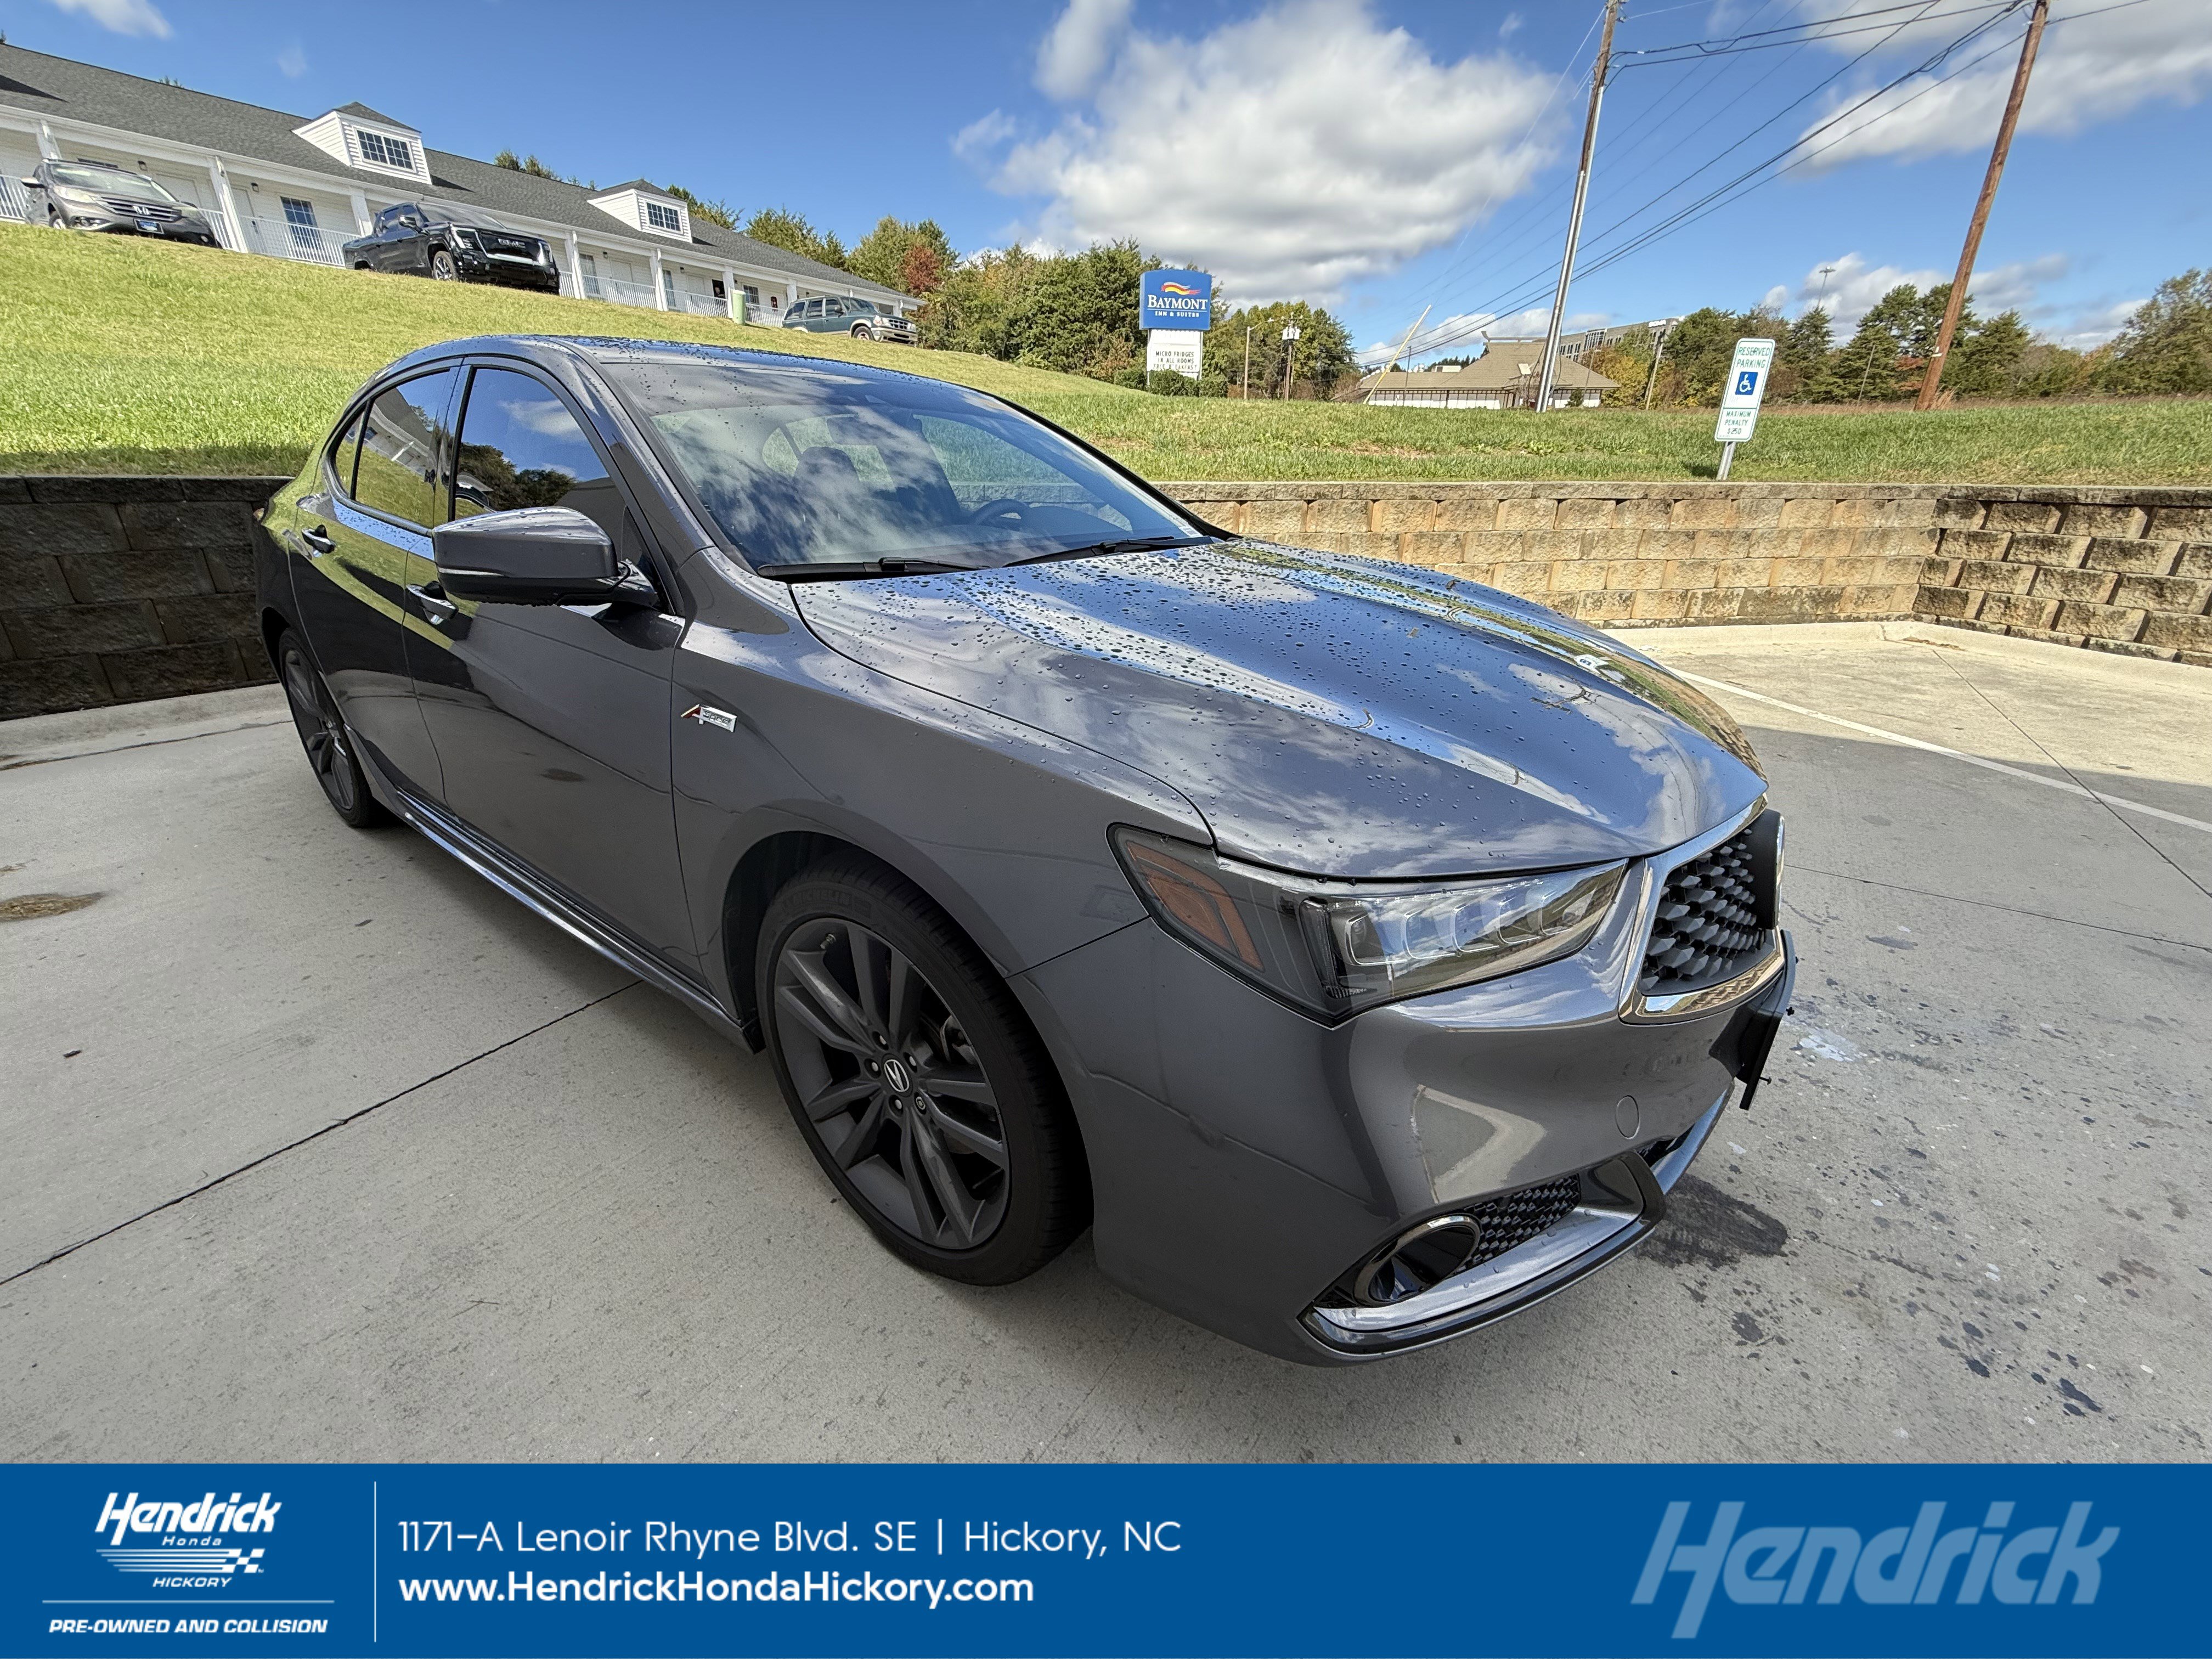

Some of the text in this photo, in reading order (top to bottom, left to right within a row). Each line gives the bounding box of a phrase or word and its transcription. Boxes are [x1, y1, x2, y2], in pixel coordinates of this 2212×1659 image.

[1147, 295, 1207, 309] BAYMONT
[1738, 347, 1770, 356] RESERVED
[1736, 359, 1766, 369] PARKING
